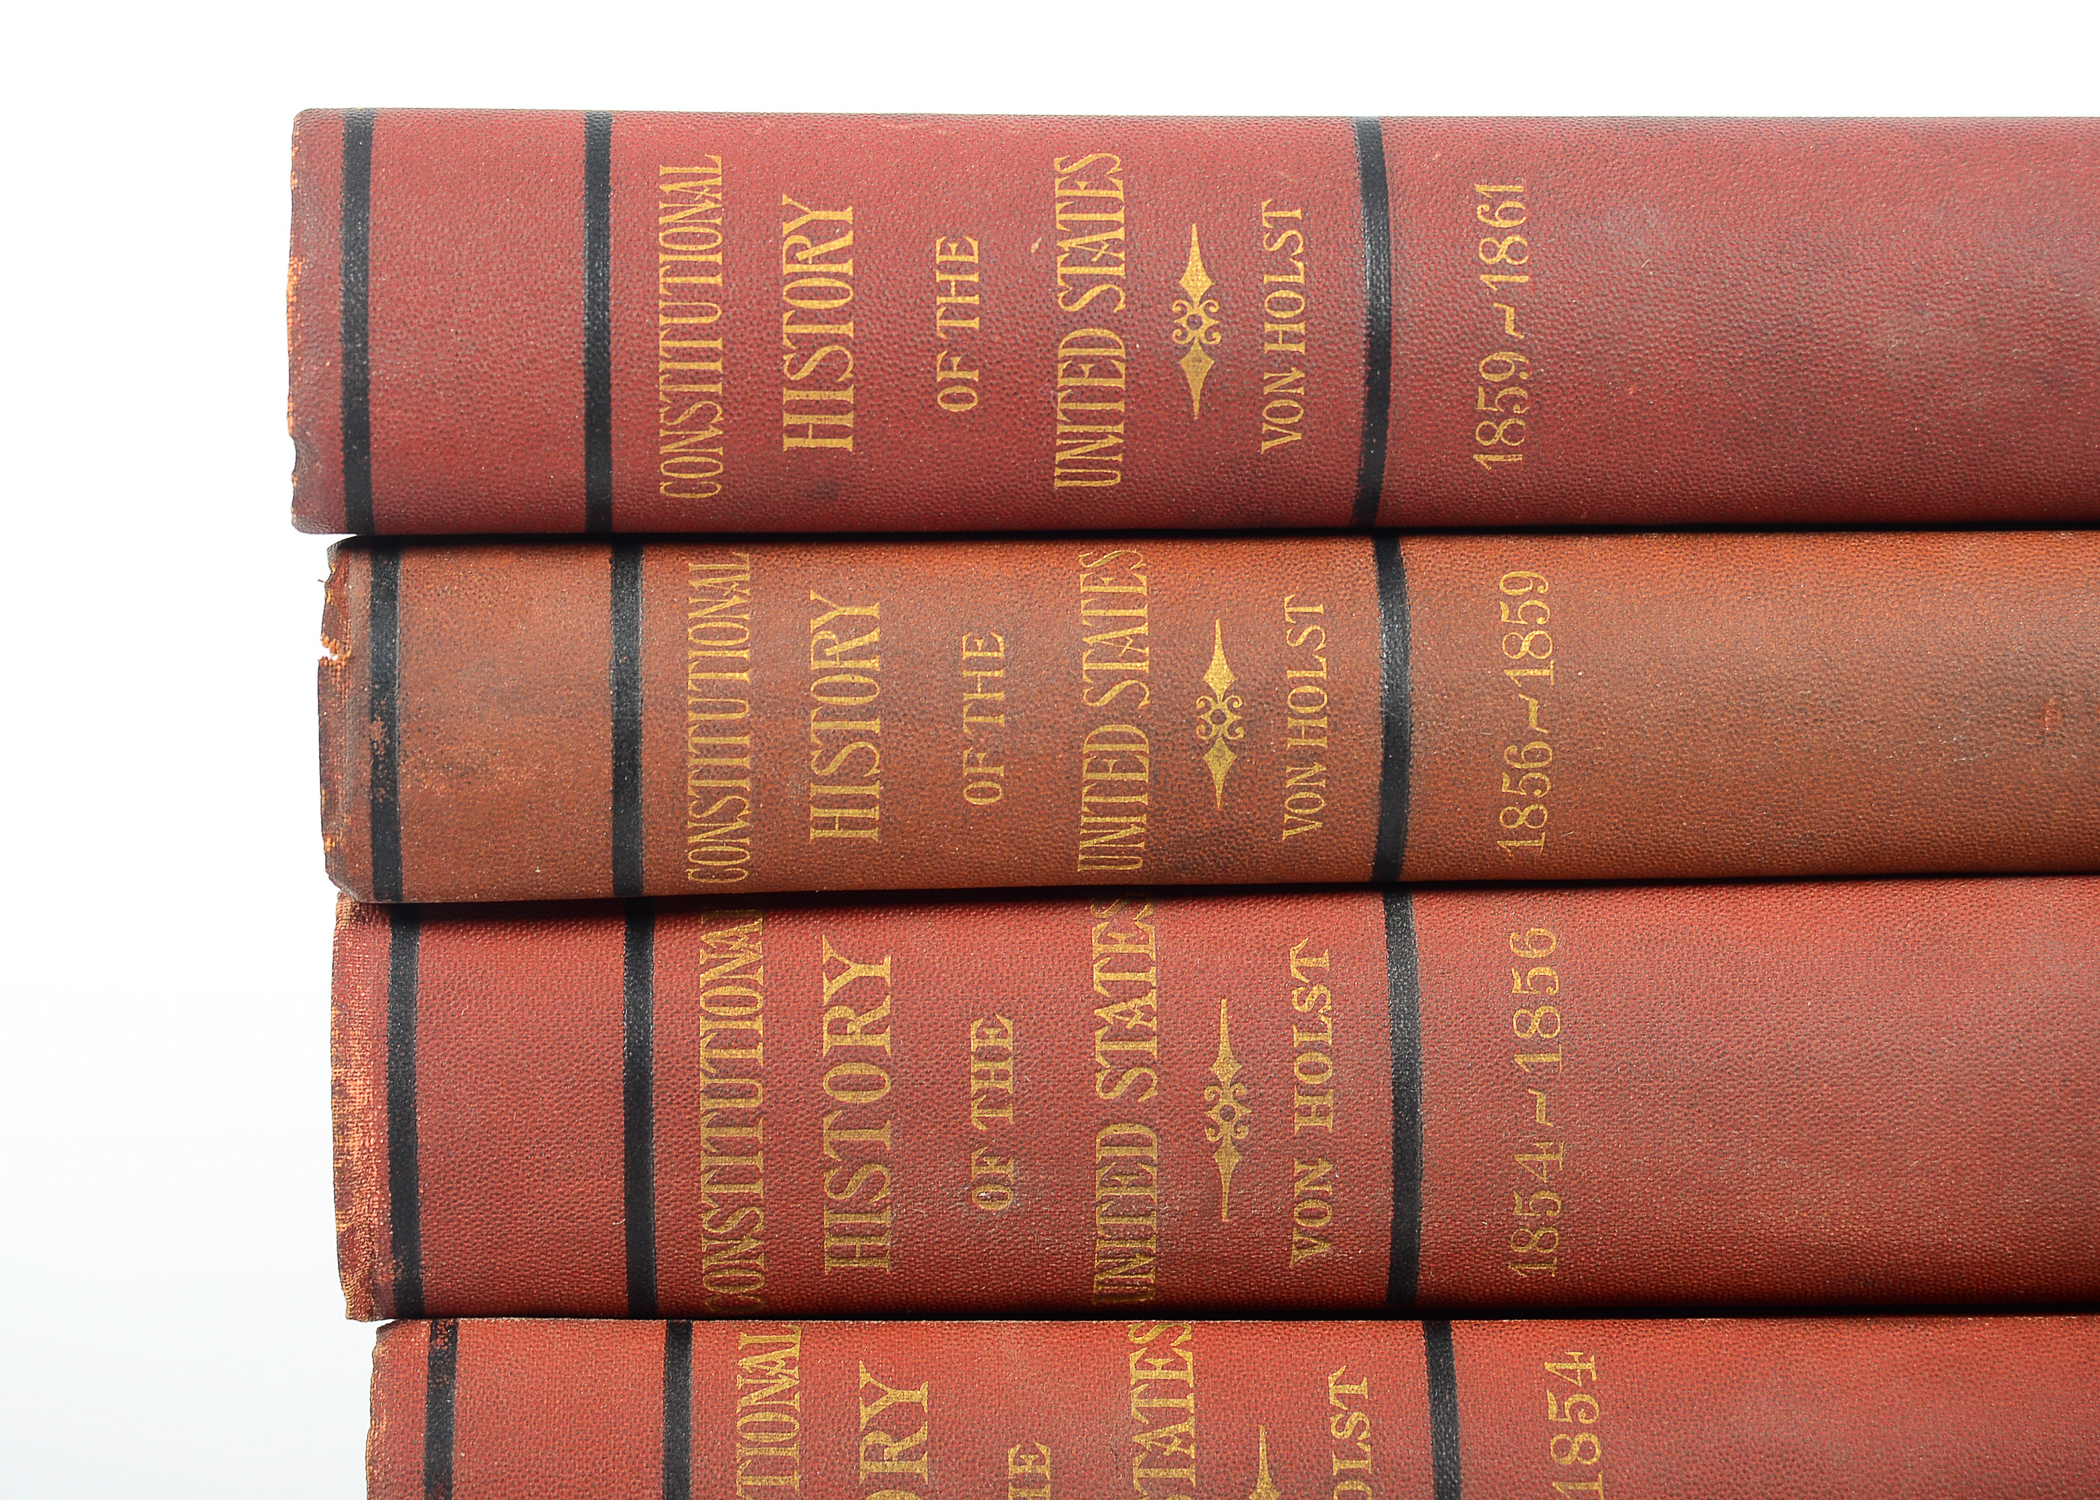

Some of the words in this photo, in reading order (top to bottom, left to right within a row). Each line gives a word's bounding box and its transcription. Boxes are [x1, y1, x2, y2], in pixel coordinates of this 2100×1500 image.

[936, 236, 980, 338] THE
[1054, 153, 1126, 312] STATES
[1262, 199, 1305, 353] HOLST
[659, 155, 724, 498] CONSTITUTIONAL
[782, 194, 854, 451] HISTORY
[937, 351, 979, 412] OF
[1055, 328, 1126, 487] UNITED
[1262, 367, 1305, 453] VON
[963, 632, 1005, 734] THE
[1079, 550, 1150, 708] STATES
[1284, 594, 1328, 748] HOLST
[686, 553, 751, 883] CONSTITUTIONAL
[810, 590, 880, 841] HISTORY
[963, 749, 1005, 805] OF
[1078, 724, 1149, 871] UNITED
[1283, 762, 1326, 840] VON
[971, 1014, 1013, 1130] THE
[1090, 893, 1158, 1103] STATES
[1290, 938, 1333, 1133] HOLST
[822, 934, 892, 1273] HISTORY
[971, 1147, 1014, 1210] OF
[1093, 1123, 1158, 1304] UNITED
[1289, 1158, 1332, 1267] VON
[1128, 1322, 1196, 1500] TATES
